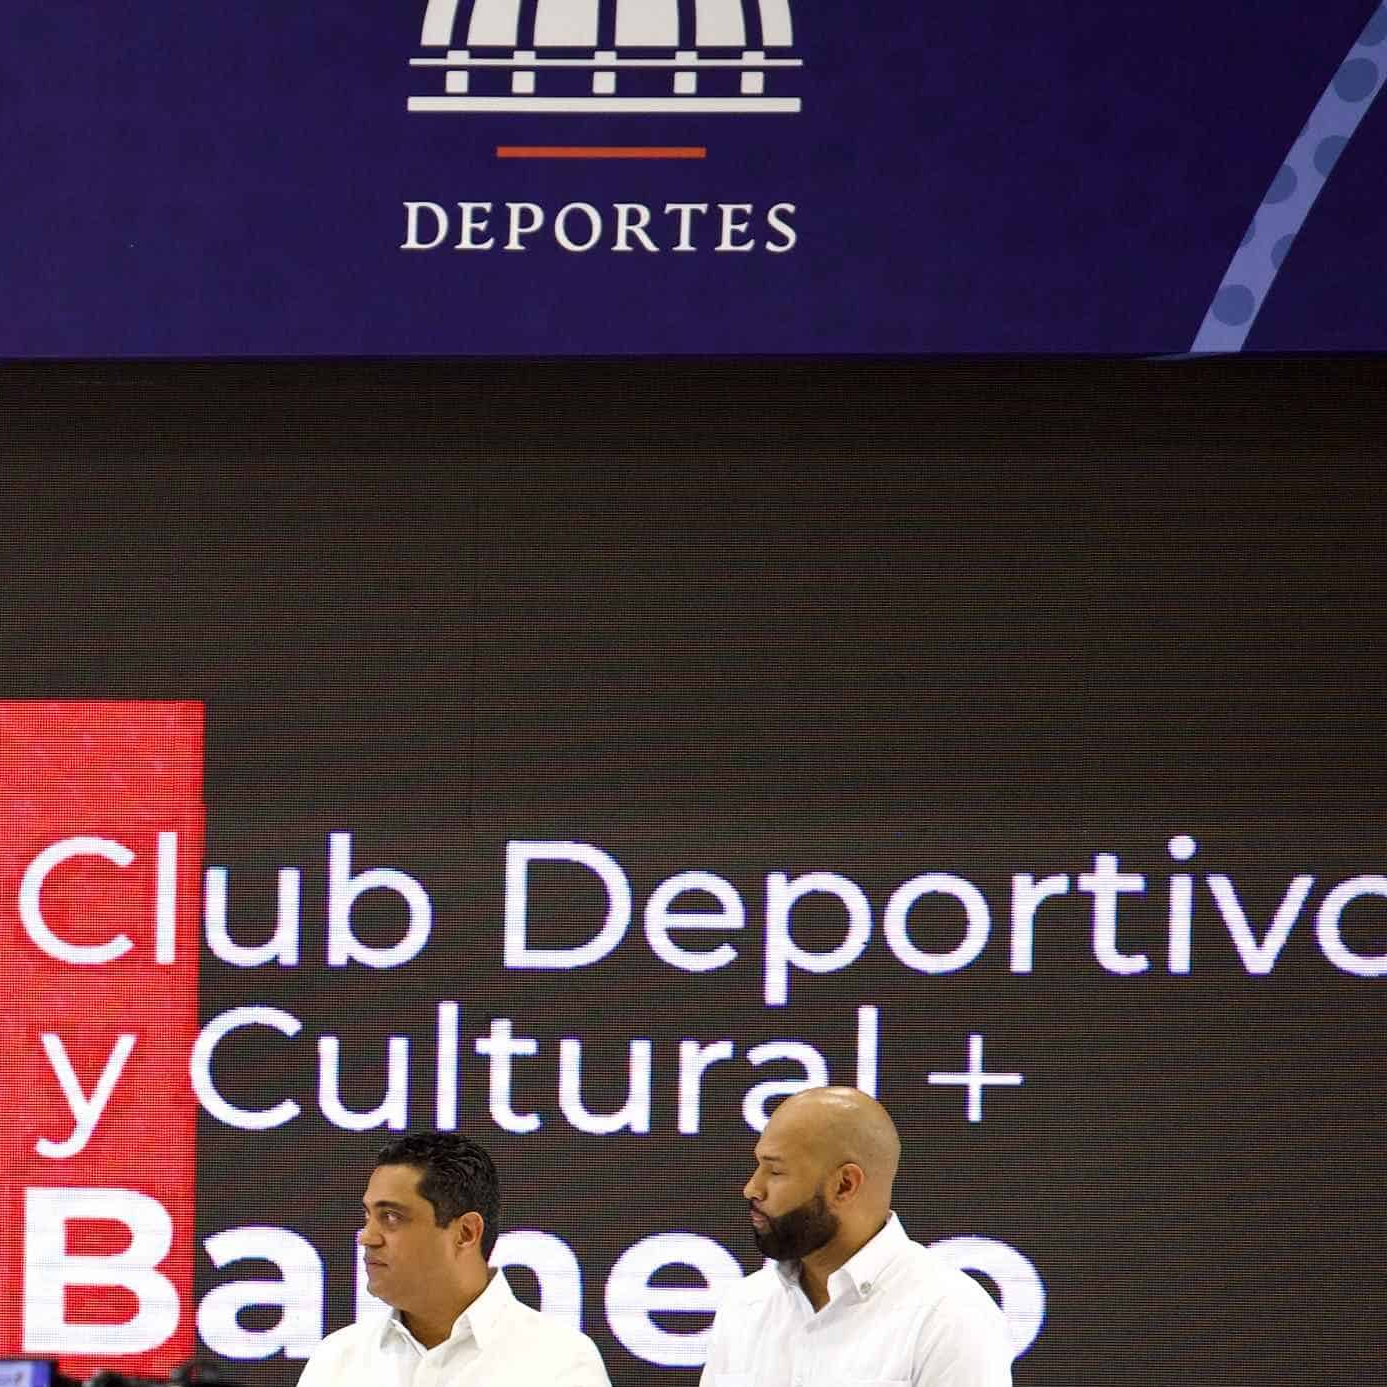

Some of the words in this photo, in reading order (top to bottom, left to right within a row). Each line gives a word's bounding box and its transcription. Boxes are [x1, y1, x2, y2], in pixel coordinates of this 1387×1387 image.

[400, 201, 797, 252] DEPORTES
[18, 832, 432, 968] Club
[34, 1032, 138, 1160] y
[190, 1001, 879, 1137] Cultural
